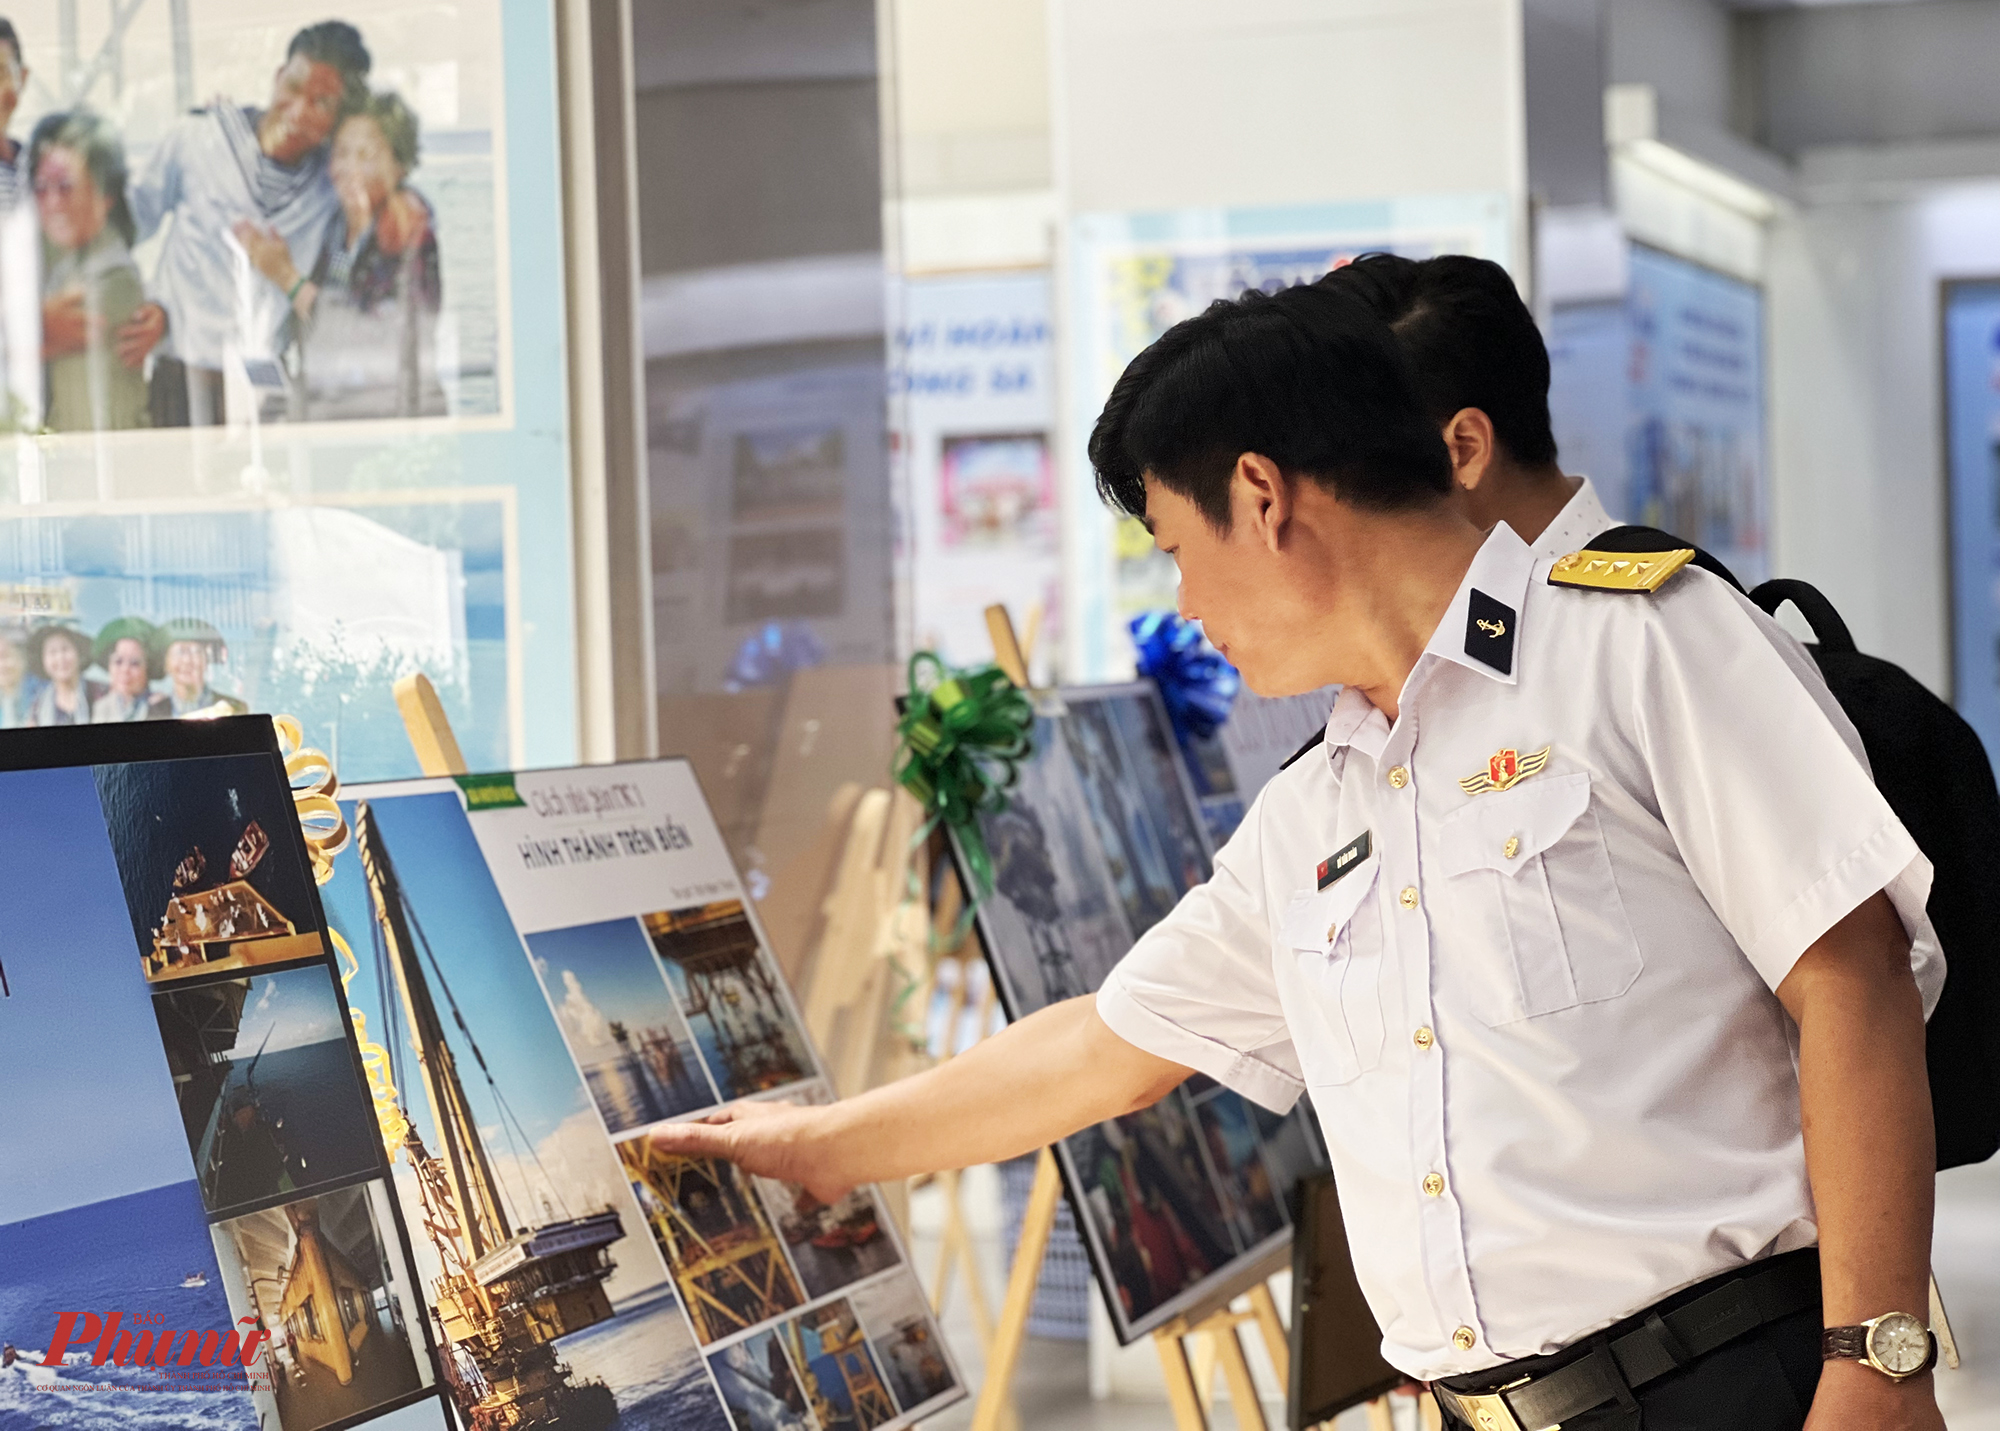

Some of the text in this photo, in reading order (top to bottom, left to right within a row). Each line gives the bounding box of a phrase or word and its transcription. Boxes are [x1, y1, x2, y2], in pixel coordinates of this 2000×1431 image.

[517, 835, 566, 870] HÌNH
[562, 829, 622, 863] THÀNH
[617, 825, 659, 857] TRÊN
